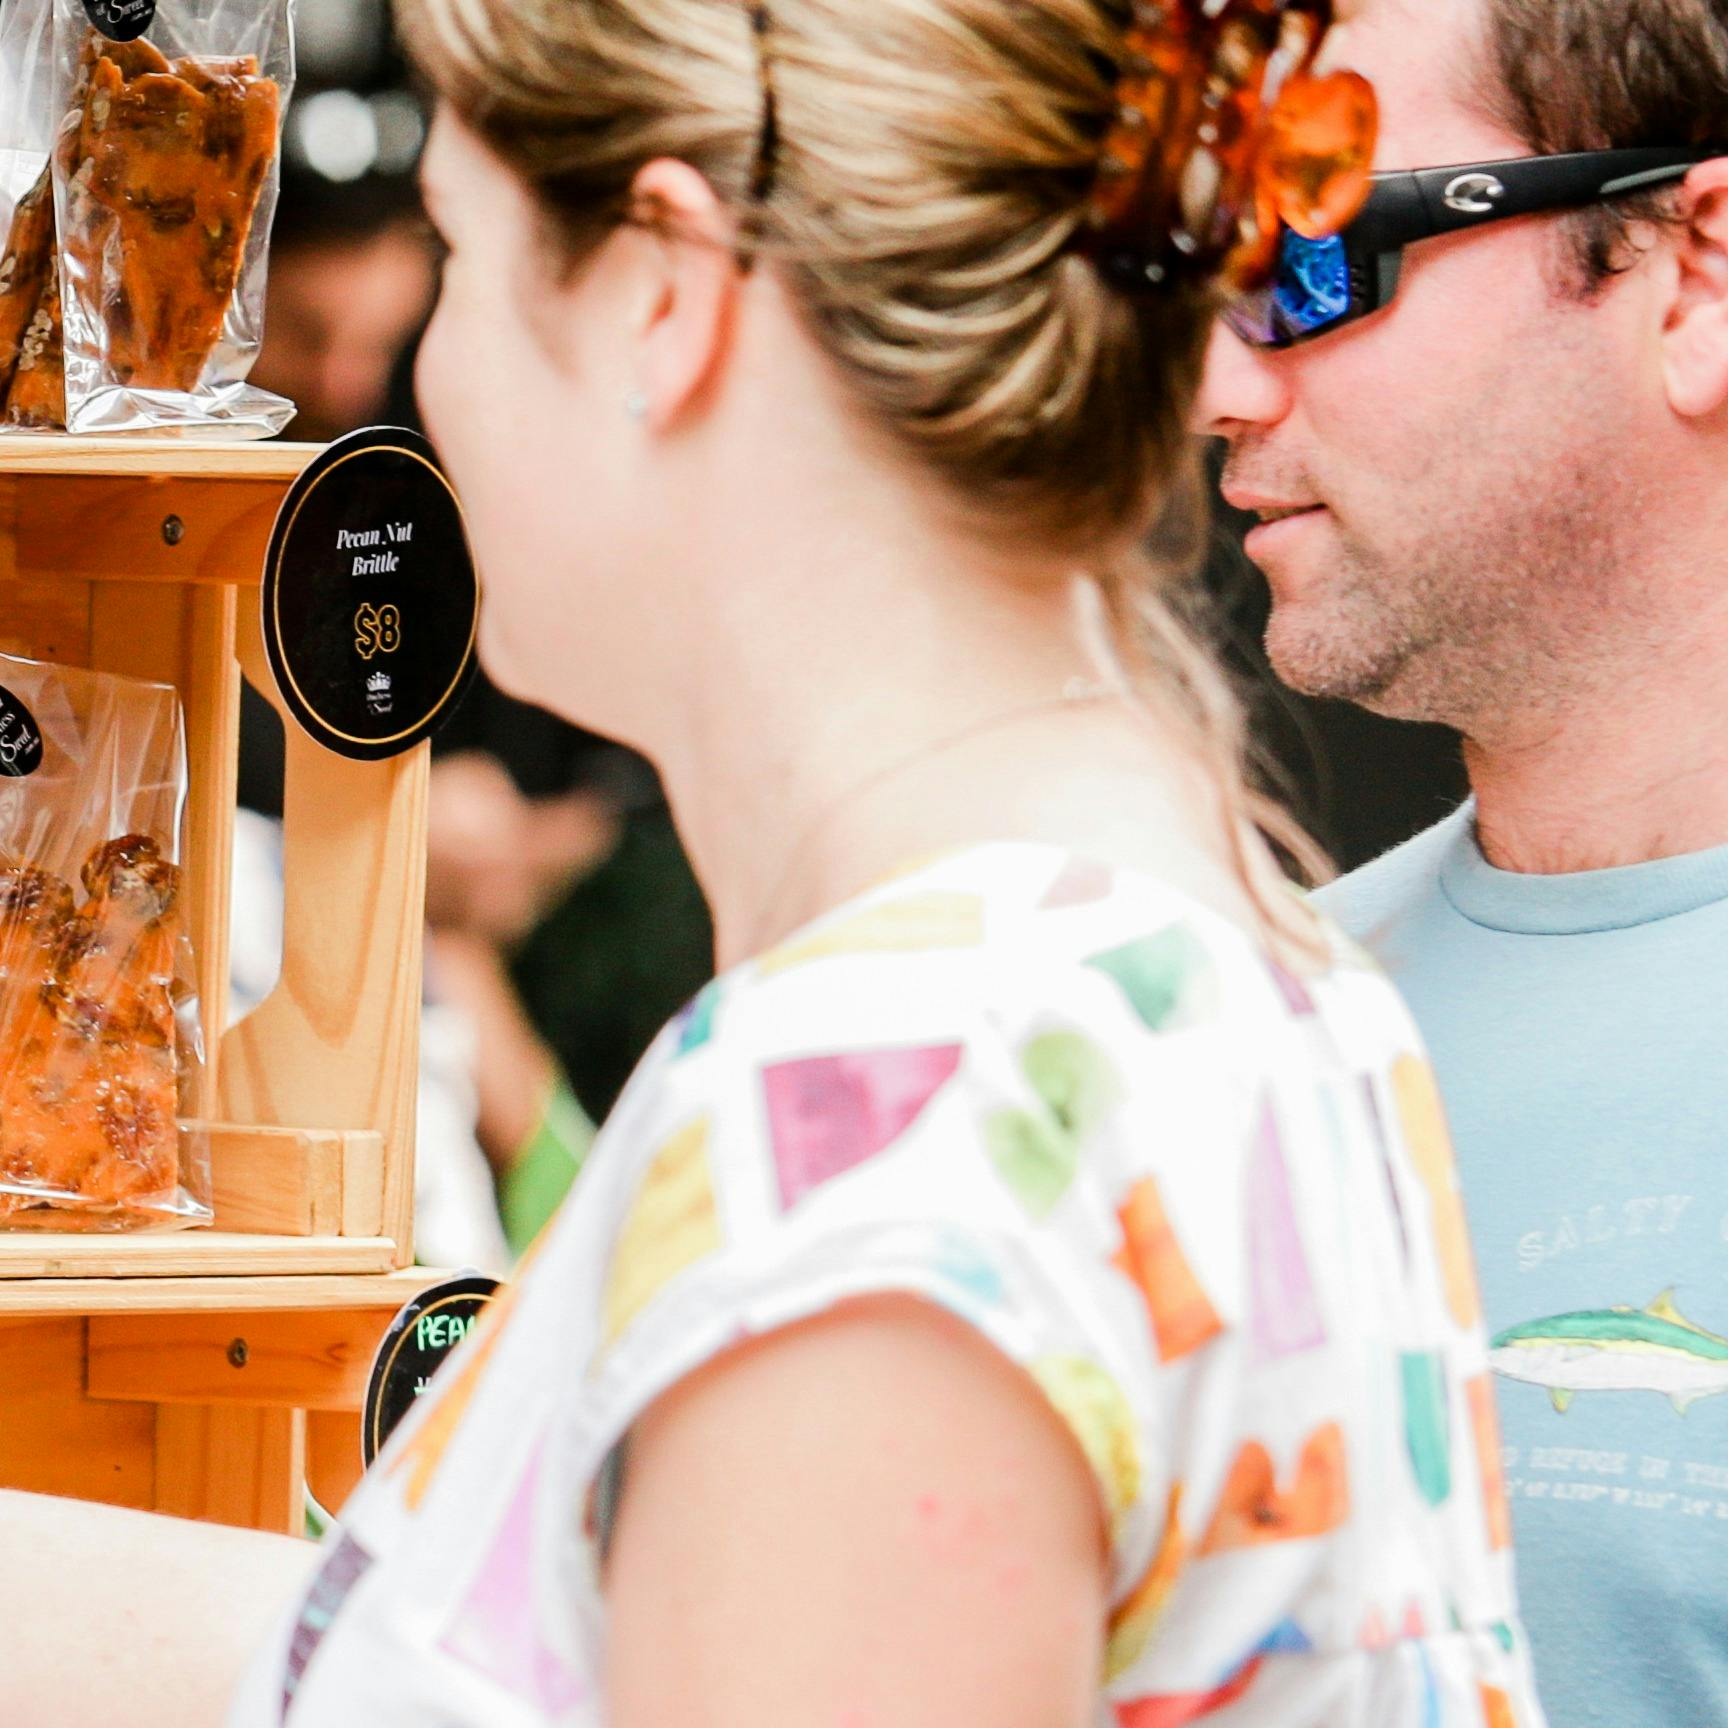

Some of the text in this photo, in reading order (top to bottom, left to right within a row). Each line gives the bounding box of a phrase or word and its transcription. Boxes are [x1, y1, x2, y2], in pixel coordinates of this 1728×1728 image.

[336, 522, 413, 549] Pecan Nut
[352, 551, 400, 576] Brittle
[355, 602, 401, 660] $8
[0, 723, 32, 762] Sweet
[1517, 1194, 1695, 1273] SALTY
